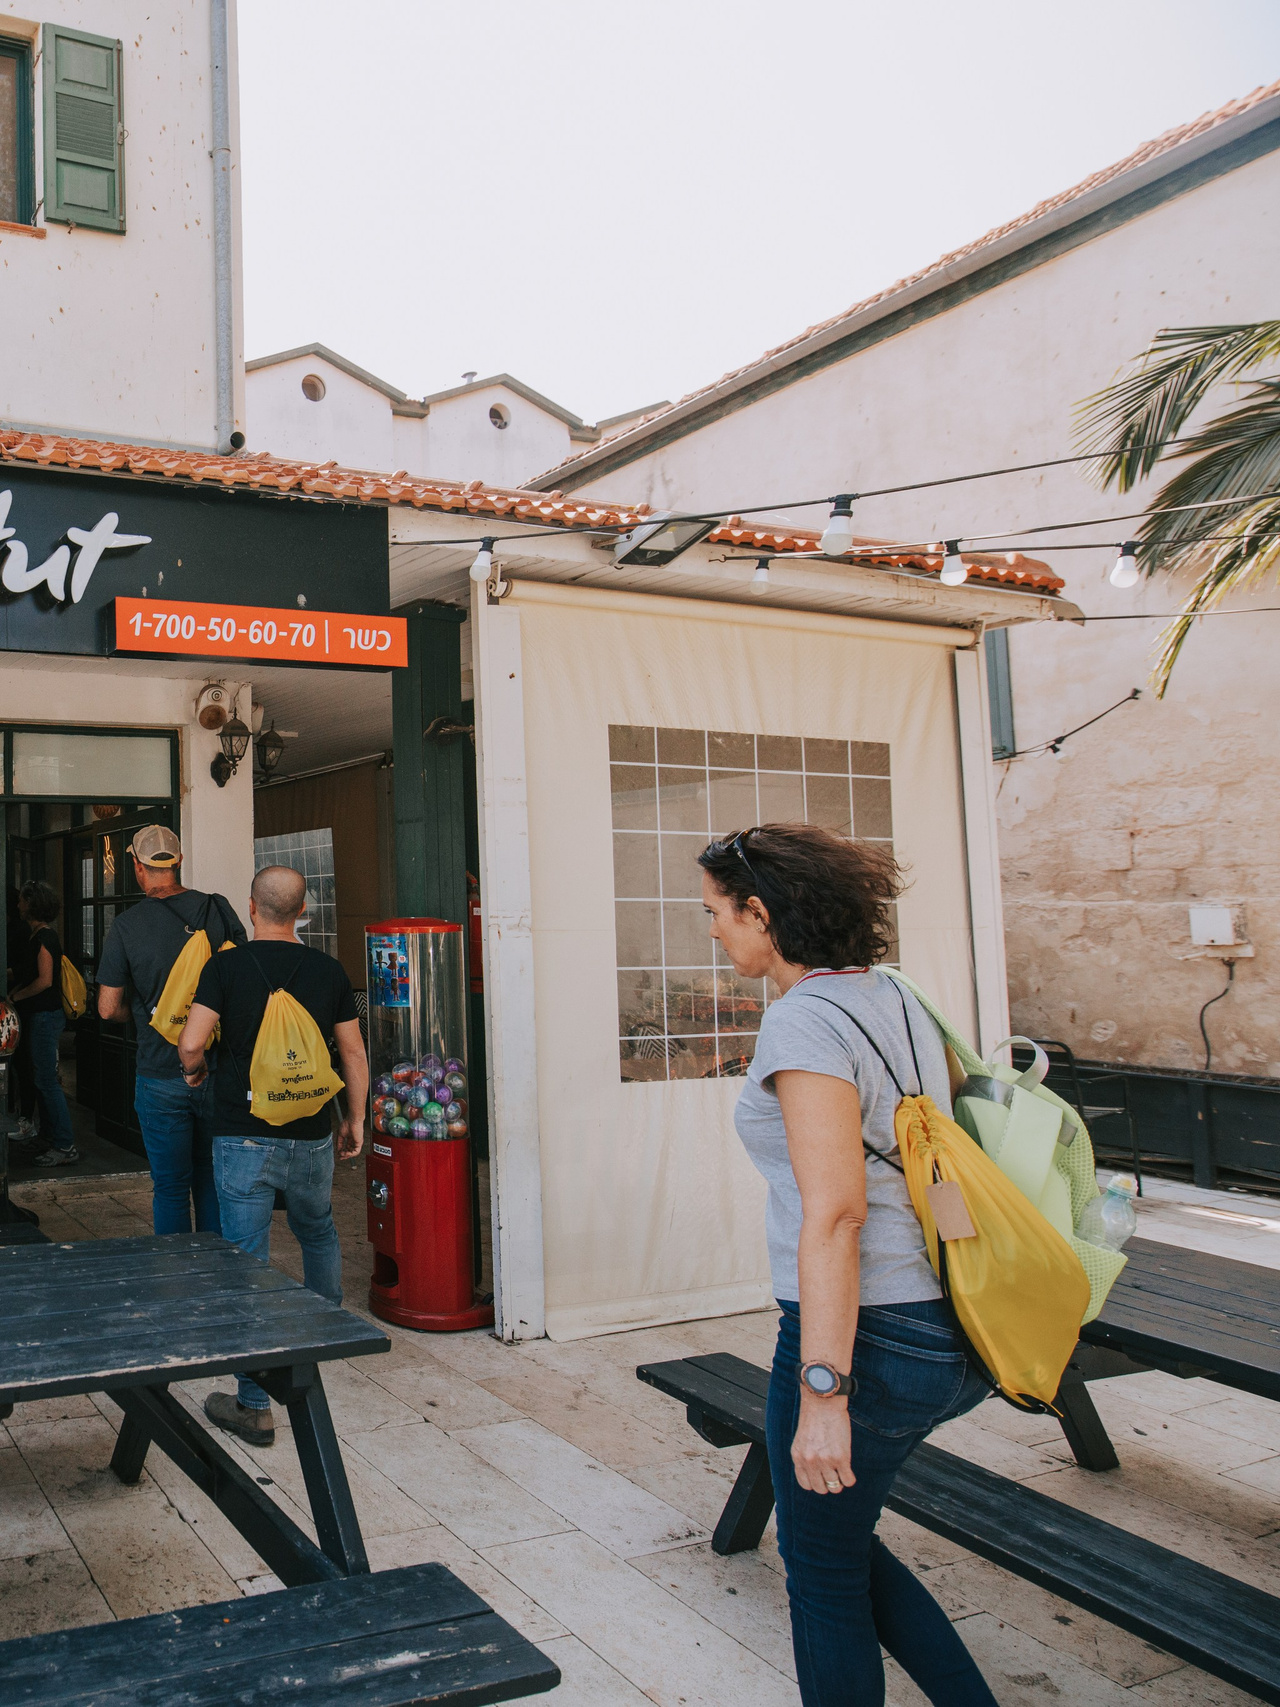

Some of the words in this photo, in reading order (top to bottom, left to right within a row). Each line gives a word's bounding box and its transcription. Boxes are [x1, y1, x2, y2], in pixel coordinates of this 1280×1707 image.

[128, 612, 316, 647] 1-700-50-60-70
[342, 627, 392, 651] כשר
[281, 1074, 314, 1084] syngenta
